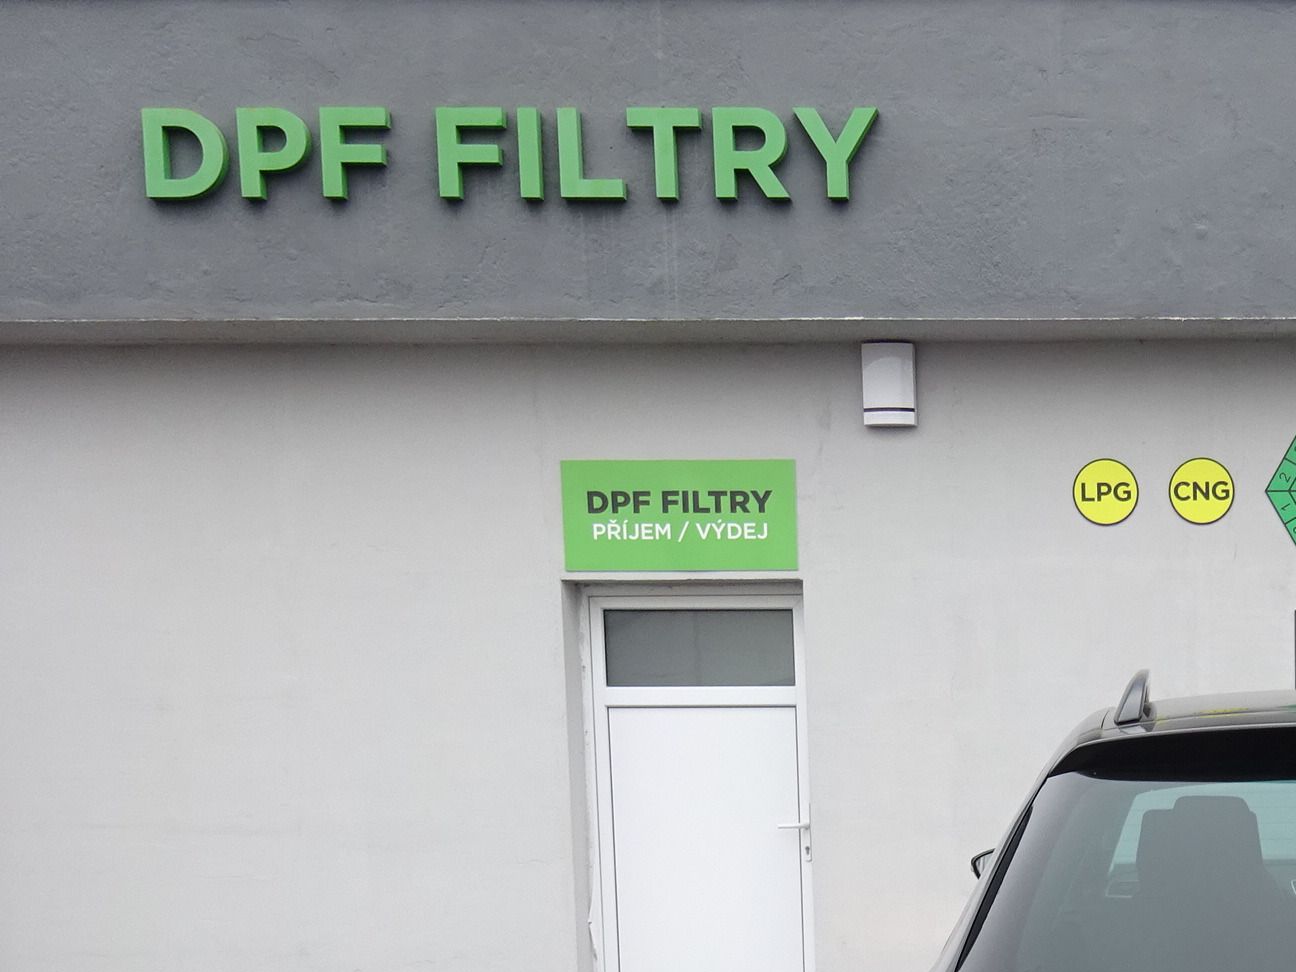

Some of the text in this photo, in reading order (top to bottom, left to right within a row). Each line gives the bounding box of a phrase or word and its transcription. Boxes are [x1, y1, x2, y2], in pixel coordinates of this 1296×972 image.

[140, 106, 879, 200] DPF FILTRY
[1279, 472, 1291, 482] 2
[1081, 482, 1132, 502] LPG
[1173, 481, 1230, 501] CNG
[586, 490, 773, 514] DPF FILTRY
[1281, 503, 1291, 511] 1
[592, 519, 672, 540] PŘÍJEM
[695, 519, 768, 540] VÝDEJ
